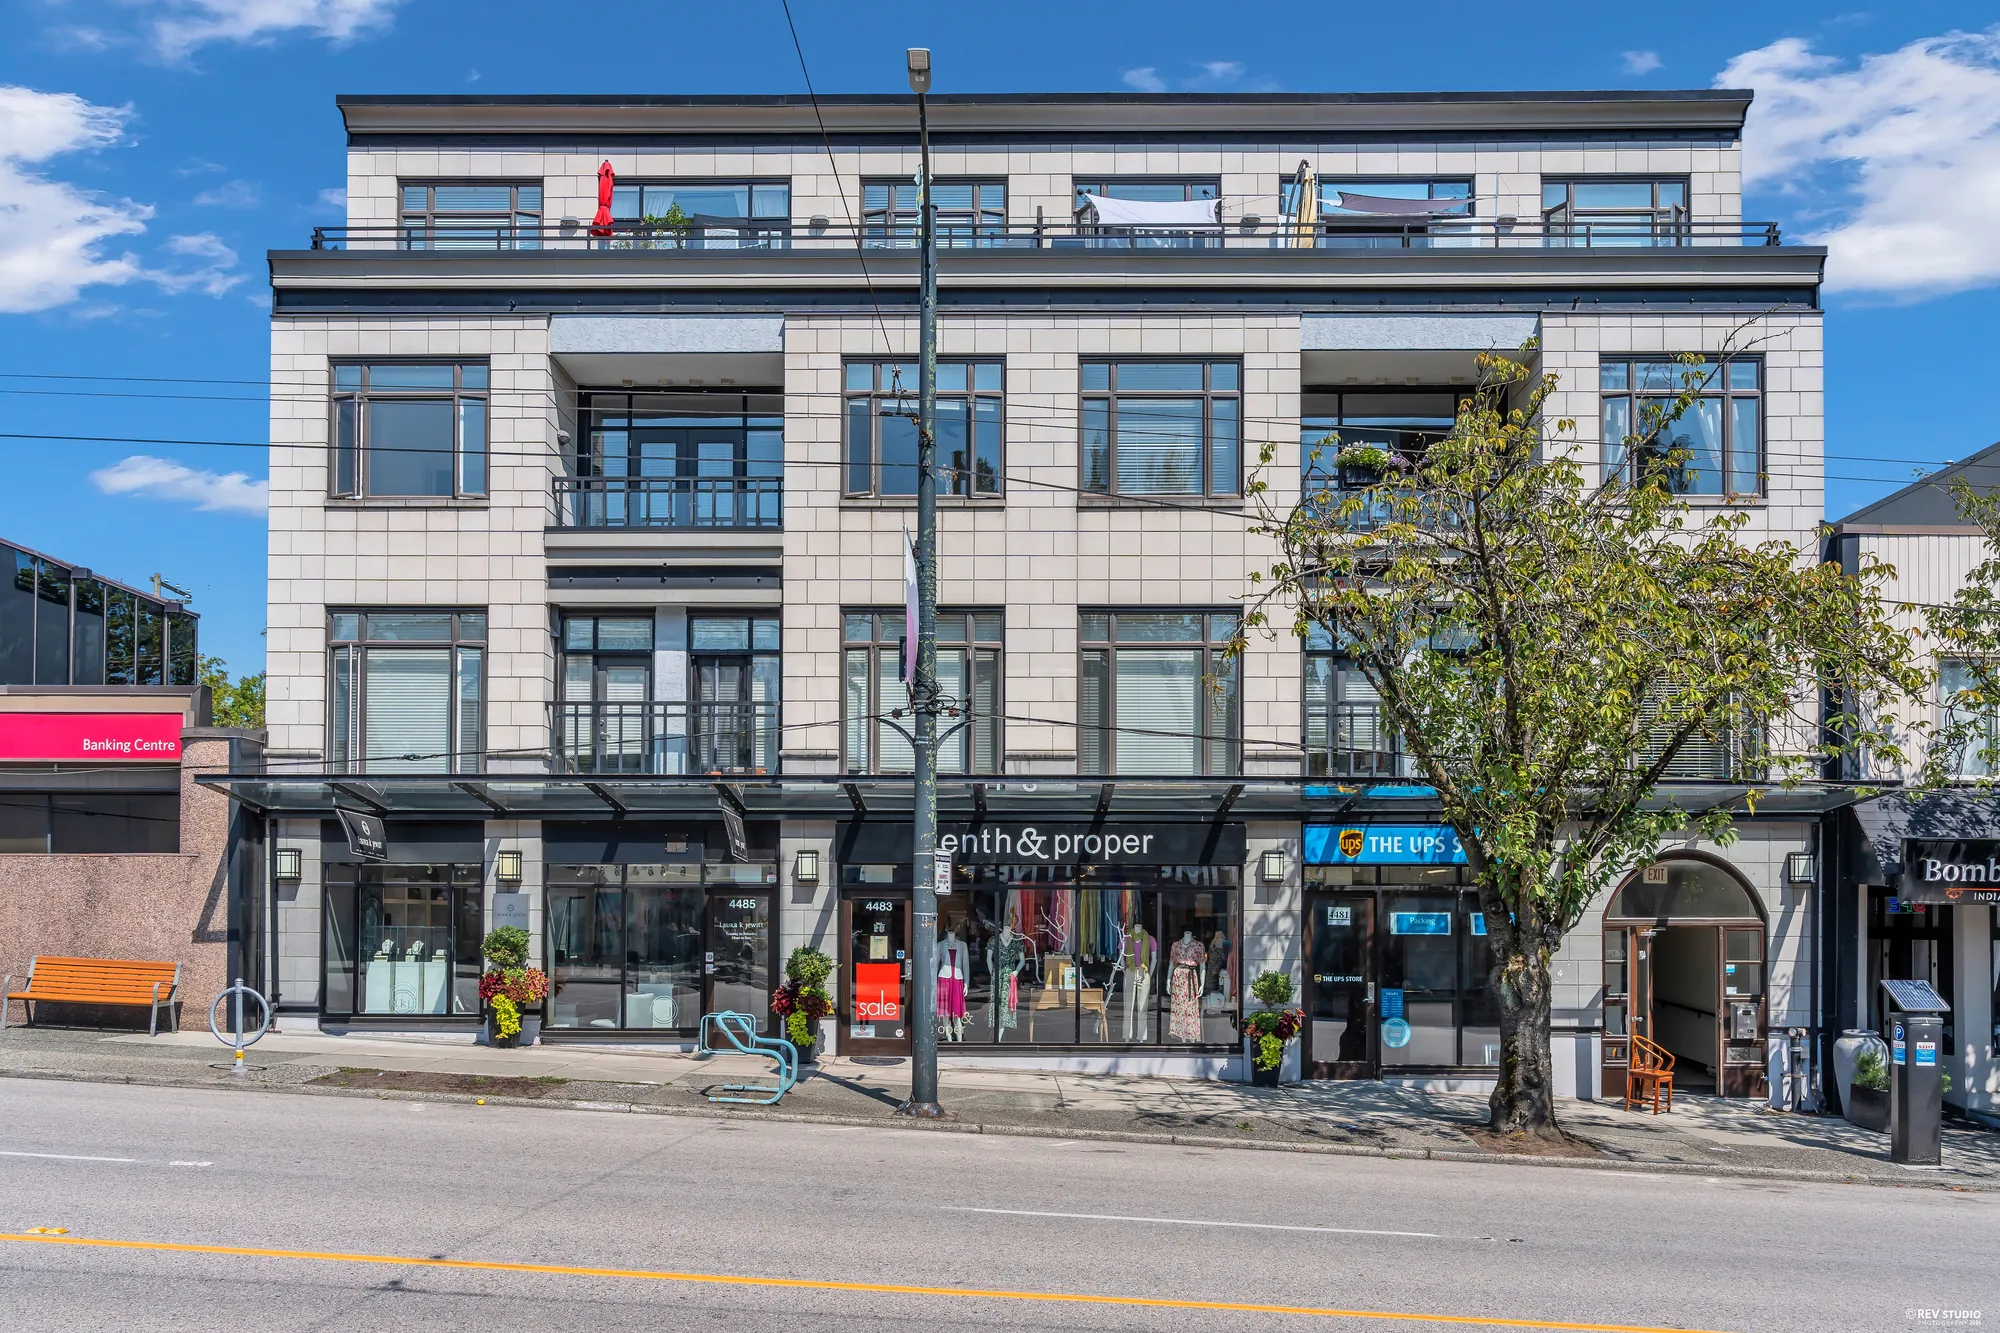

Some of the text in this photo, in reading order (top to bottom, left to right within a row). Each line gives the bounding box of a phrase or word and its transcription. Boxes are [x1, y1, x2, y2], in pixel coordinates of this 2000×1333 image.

[83, 738, 175, 753] Banking Centre
[1341, 838, 1361, 854] ups
[1369, 836, 1402, 853] THE
[1410, 836, 1445, 853] UPS
[1648, 868, 1665, 880] EXIT
[729, 899, 756, 909] 4485
[866, 901, 892, 911] 4483
[1329, 908, 1349, 919] 4481
[1409, 917, 1436, 926] Packing
[859, 990, 897, 1016] sale
